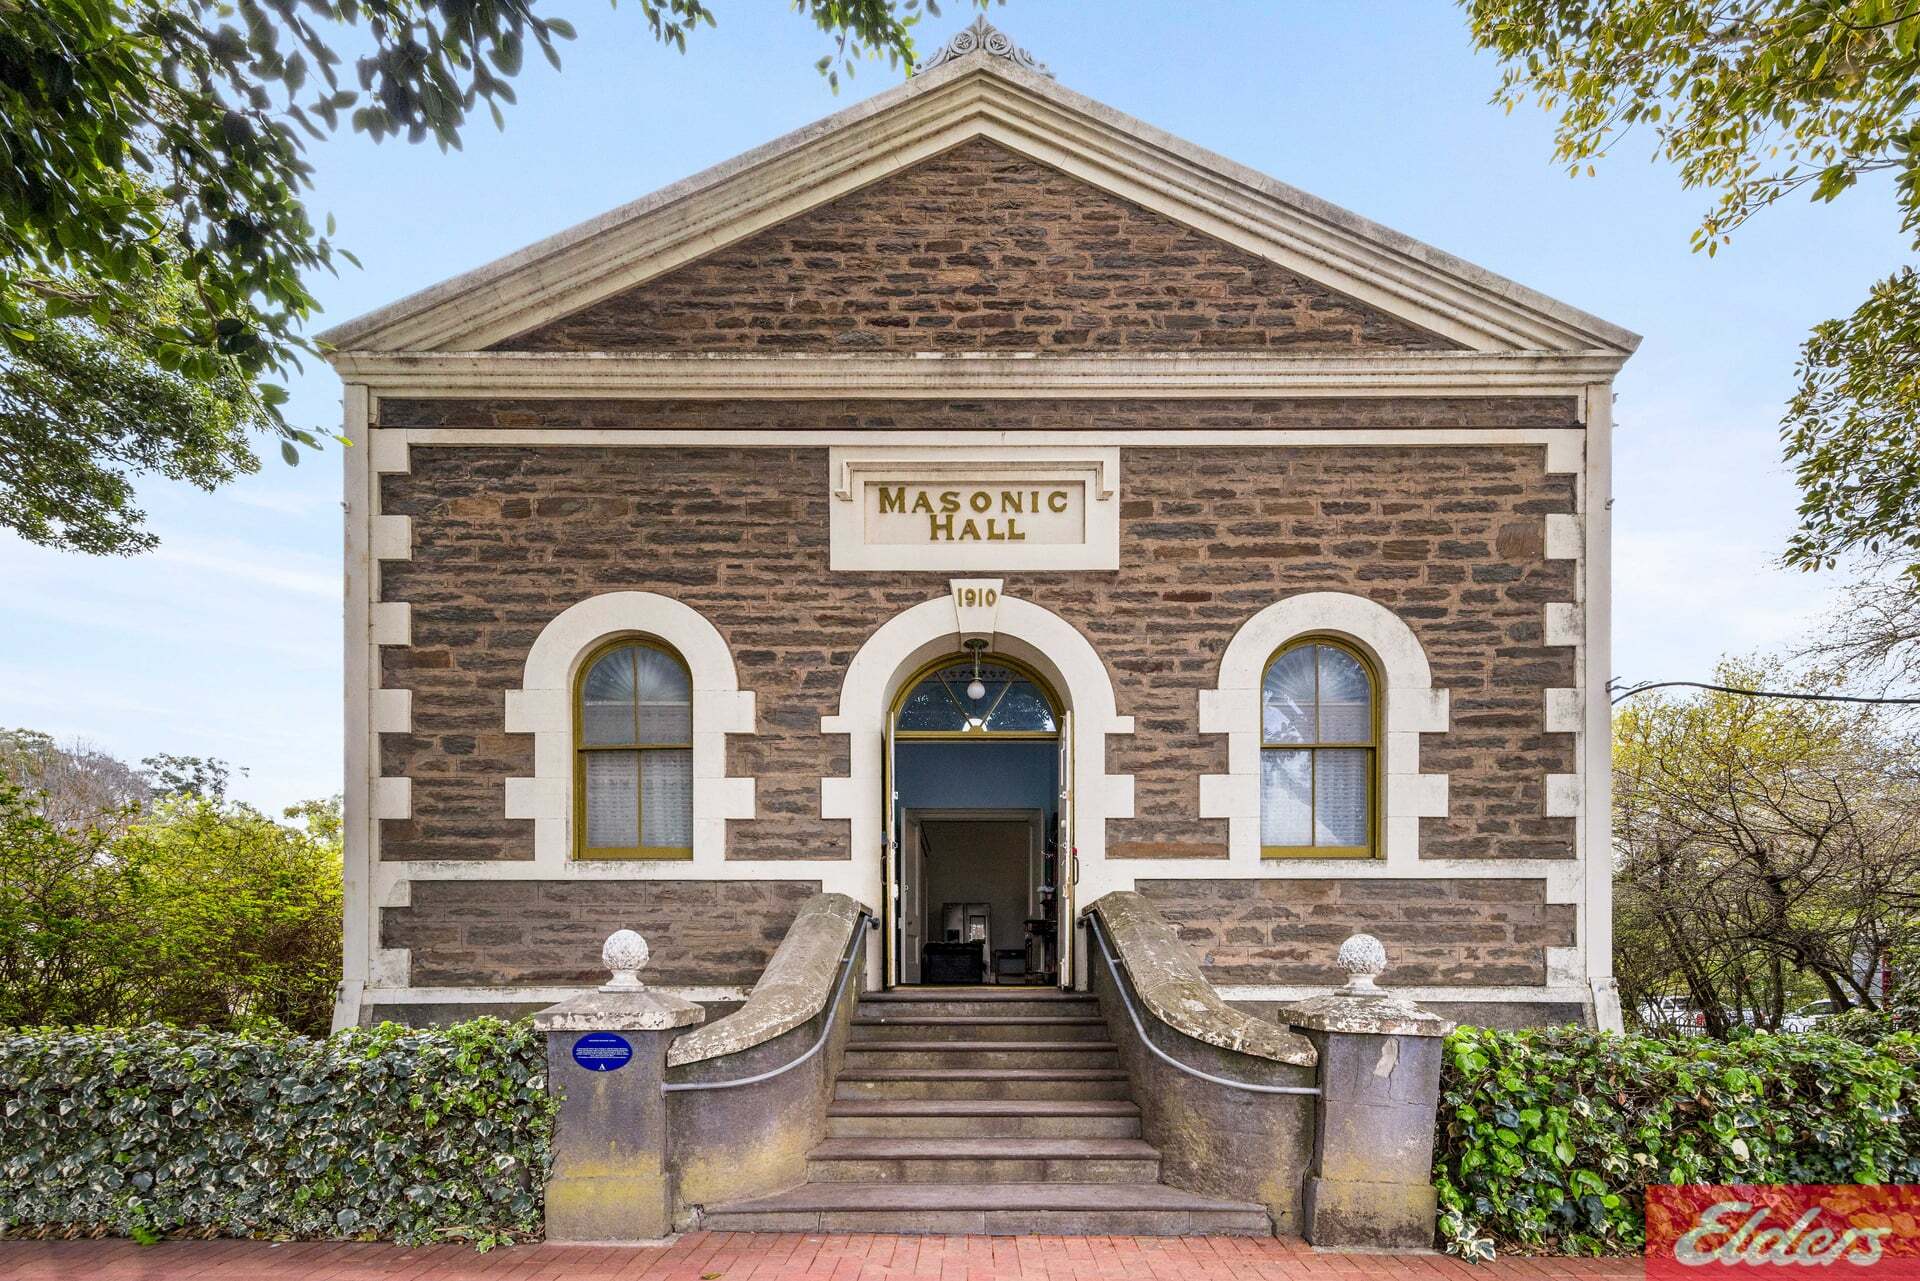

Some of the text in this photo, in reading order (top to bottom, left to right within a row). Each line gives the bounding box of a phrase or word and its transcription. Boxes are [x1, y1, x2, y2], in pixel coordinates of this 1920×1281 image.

[878, 487, 1068, 513] MASONIC
[929, 514, 1026, 540] HALL
[957, 587, 997, 608] 1910
